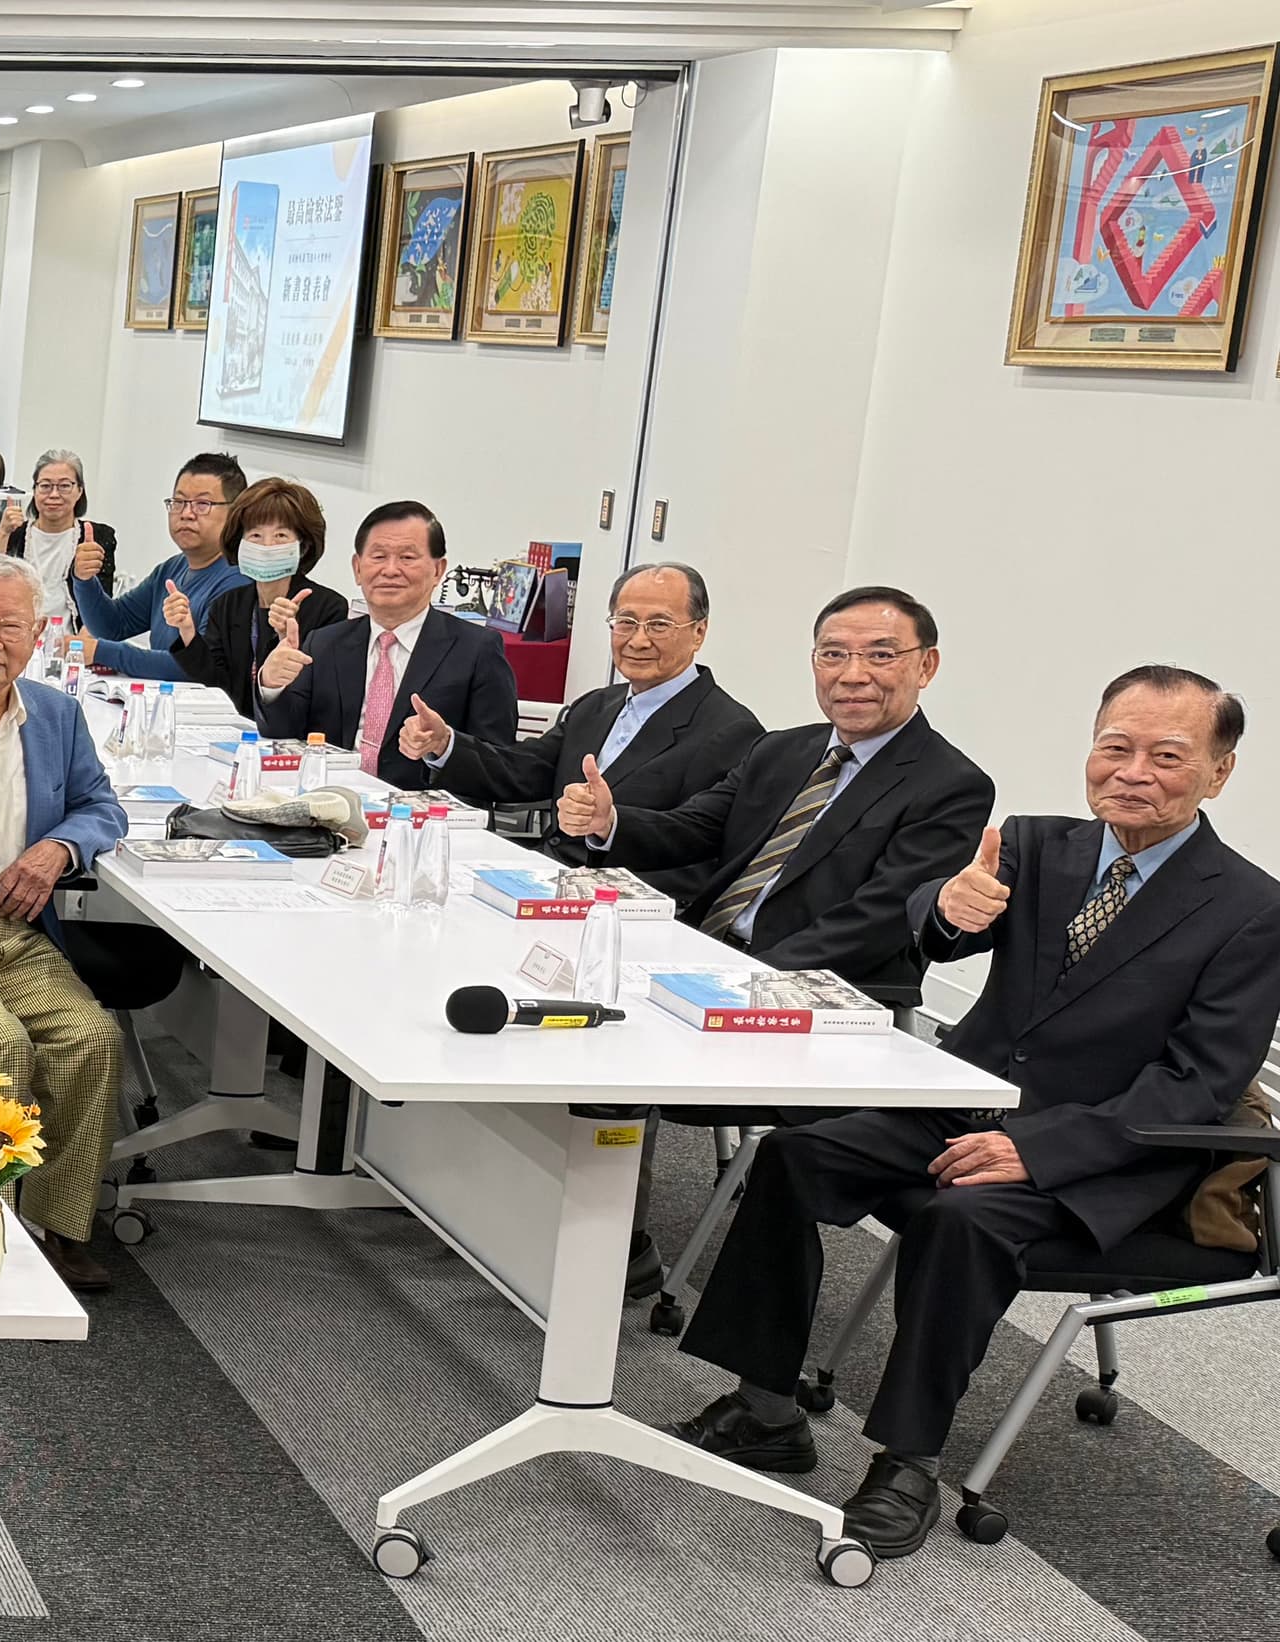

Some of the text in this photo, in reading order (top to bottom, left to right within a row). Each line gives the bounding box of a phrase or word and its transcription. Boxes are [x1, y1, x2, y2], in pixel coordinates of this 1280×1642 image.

[282, 274, 332, 303] 新書發表會
